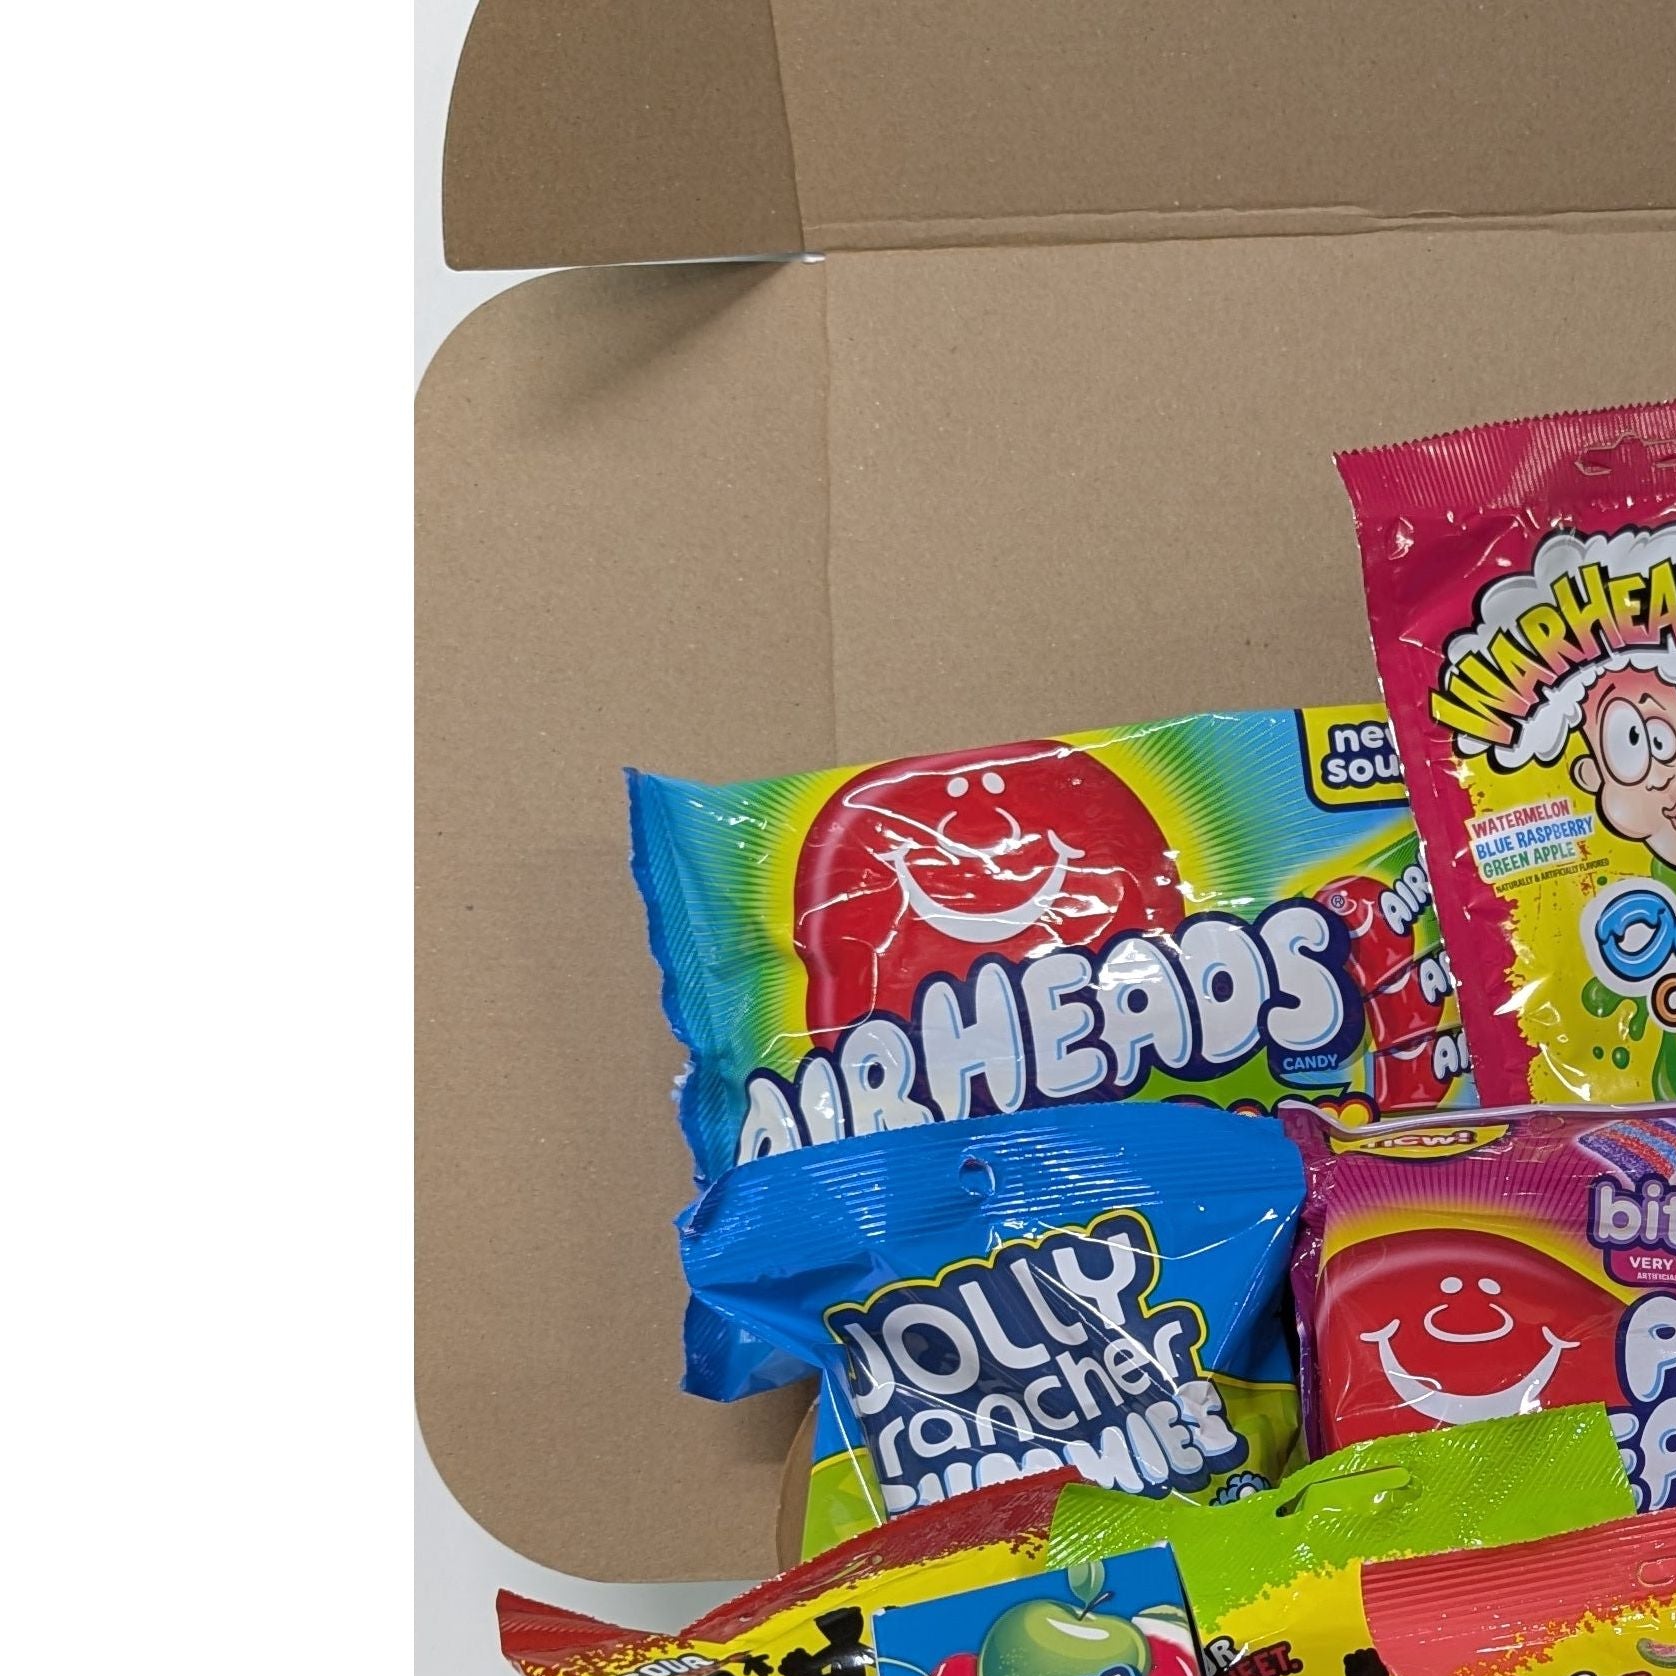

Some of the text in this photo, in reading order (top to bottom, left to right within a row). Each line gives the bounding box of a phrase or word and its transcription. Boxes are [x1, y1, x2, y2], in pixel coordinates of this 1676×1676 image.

[1327, 755, 1401, 784] sou
[1471, 799, 1571, 839] WATERMELON
[1475, 816, 1594, 861] BLUE RASPBERRY
[1482, 841, 1577, 879] GREEN APPLE
[735, 905, 1346, 1166] AIRHEADS
[1282, 1053, 1339, 1072] CANDY
[1628, 1255, 1675, 1271] VERY
[846, 1232, 1137, 1416] JOLLY
[878, 1318, 1184, 1480] rancher
